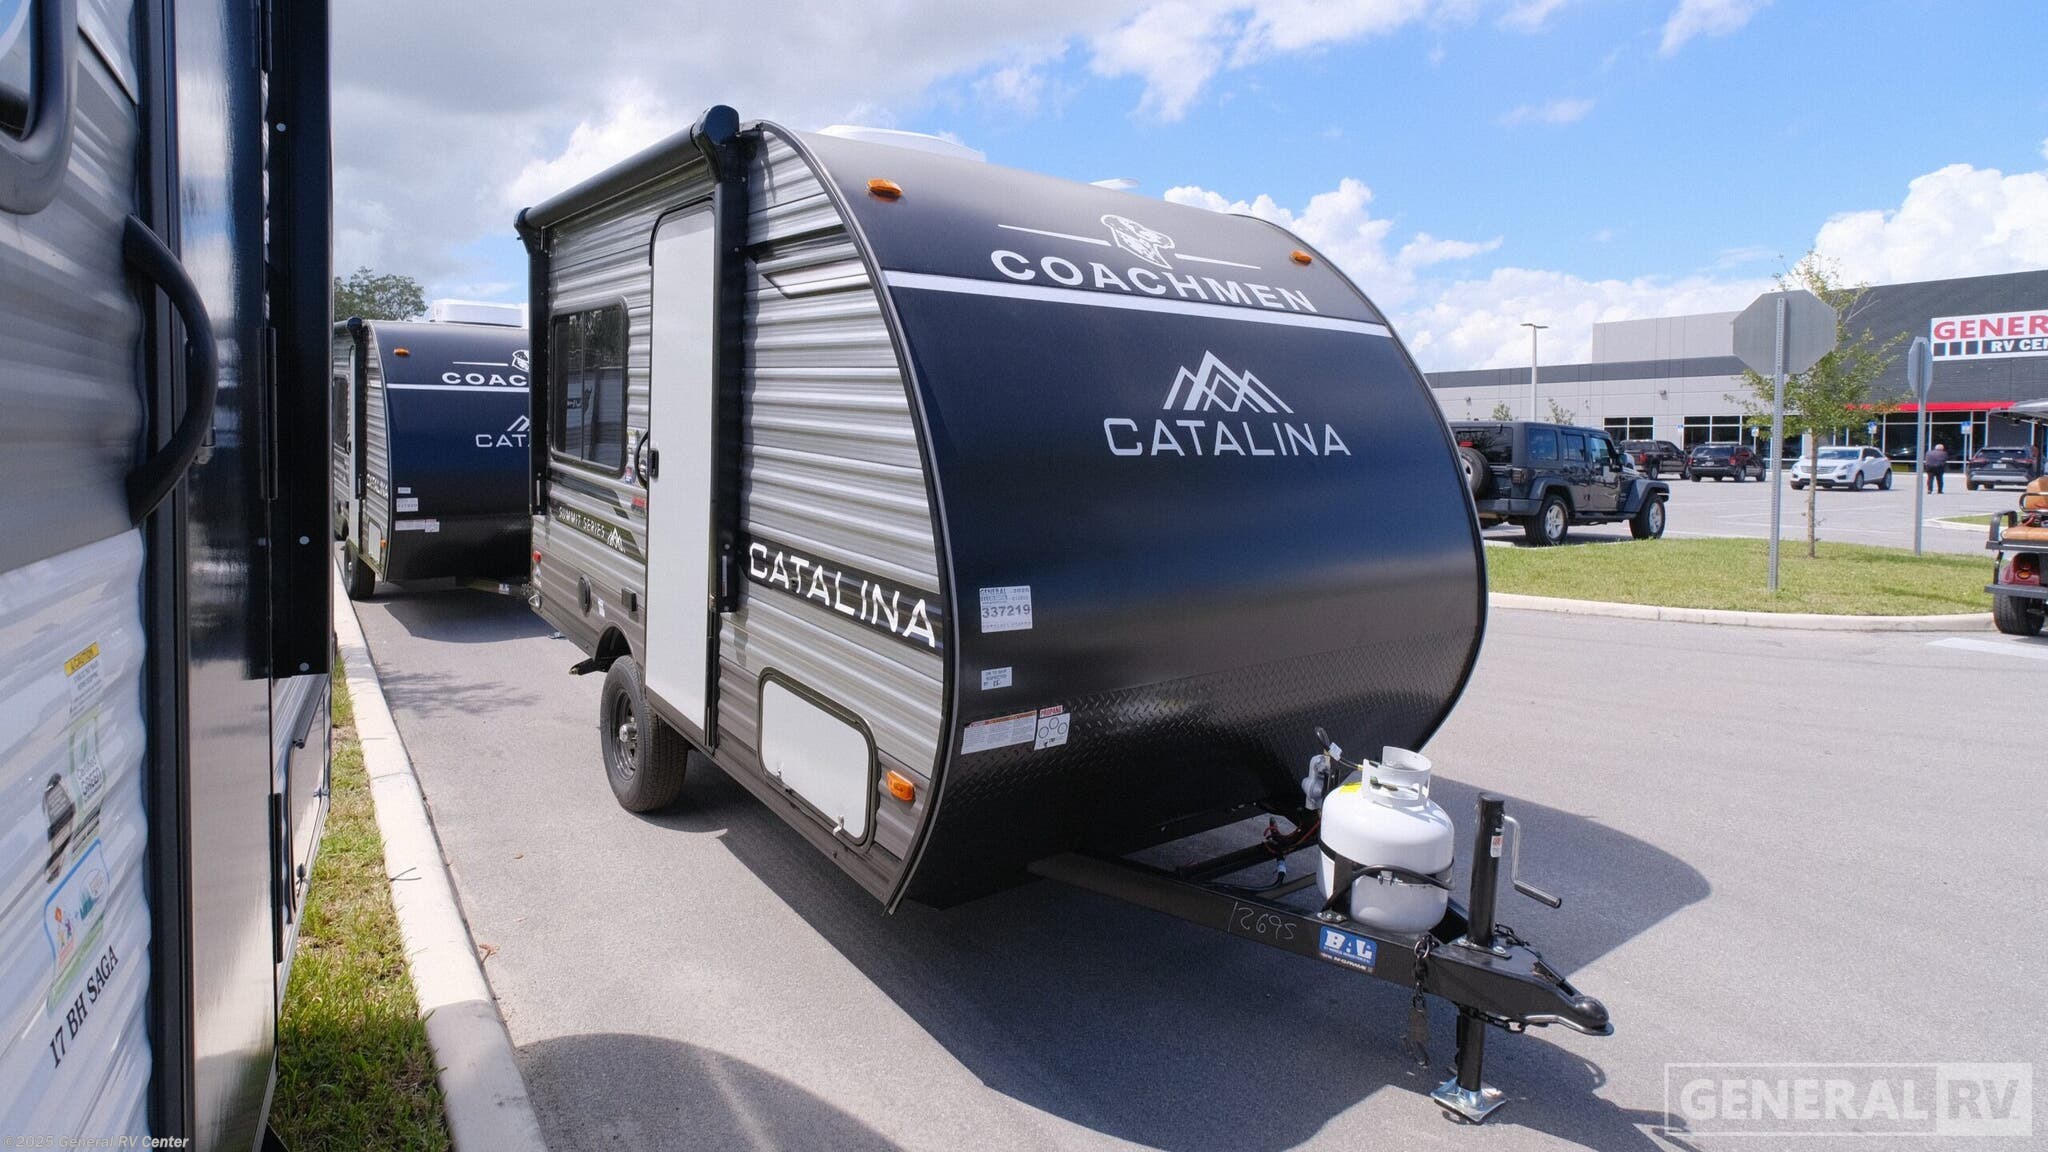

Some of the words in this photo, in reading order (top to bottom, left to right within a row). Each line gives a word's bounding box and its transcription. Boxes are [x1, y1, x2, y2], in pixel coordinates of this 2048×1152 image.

[990, 249, 1318, 313] COACHMEN
[1934, 315, 2048, 340] GENER
[1991, 340, 2014, 352] RV
[475, 434, 530, 448] CAT
[1103, 417, 1352, 457] CATALINA
[750, 542, 936, 648] CATALINA
[981, 603, 1031, 619] 337219
[66, 992, 88, 1041] BH
[86, 945, 119, 1004] SAGA
